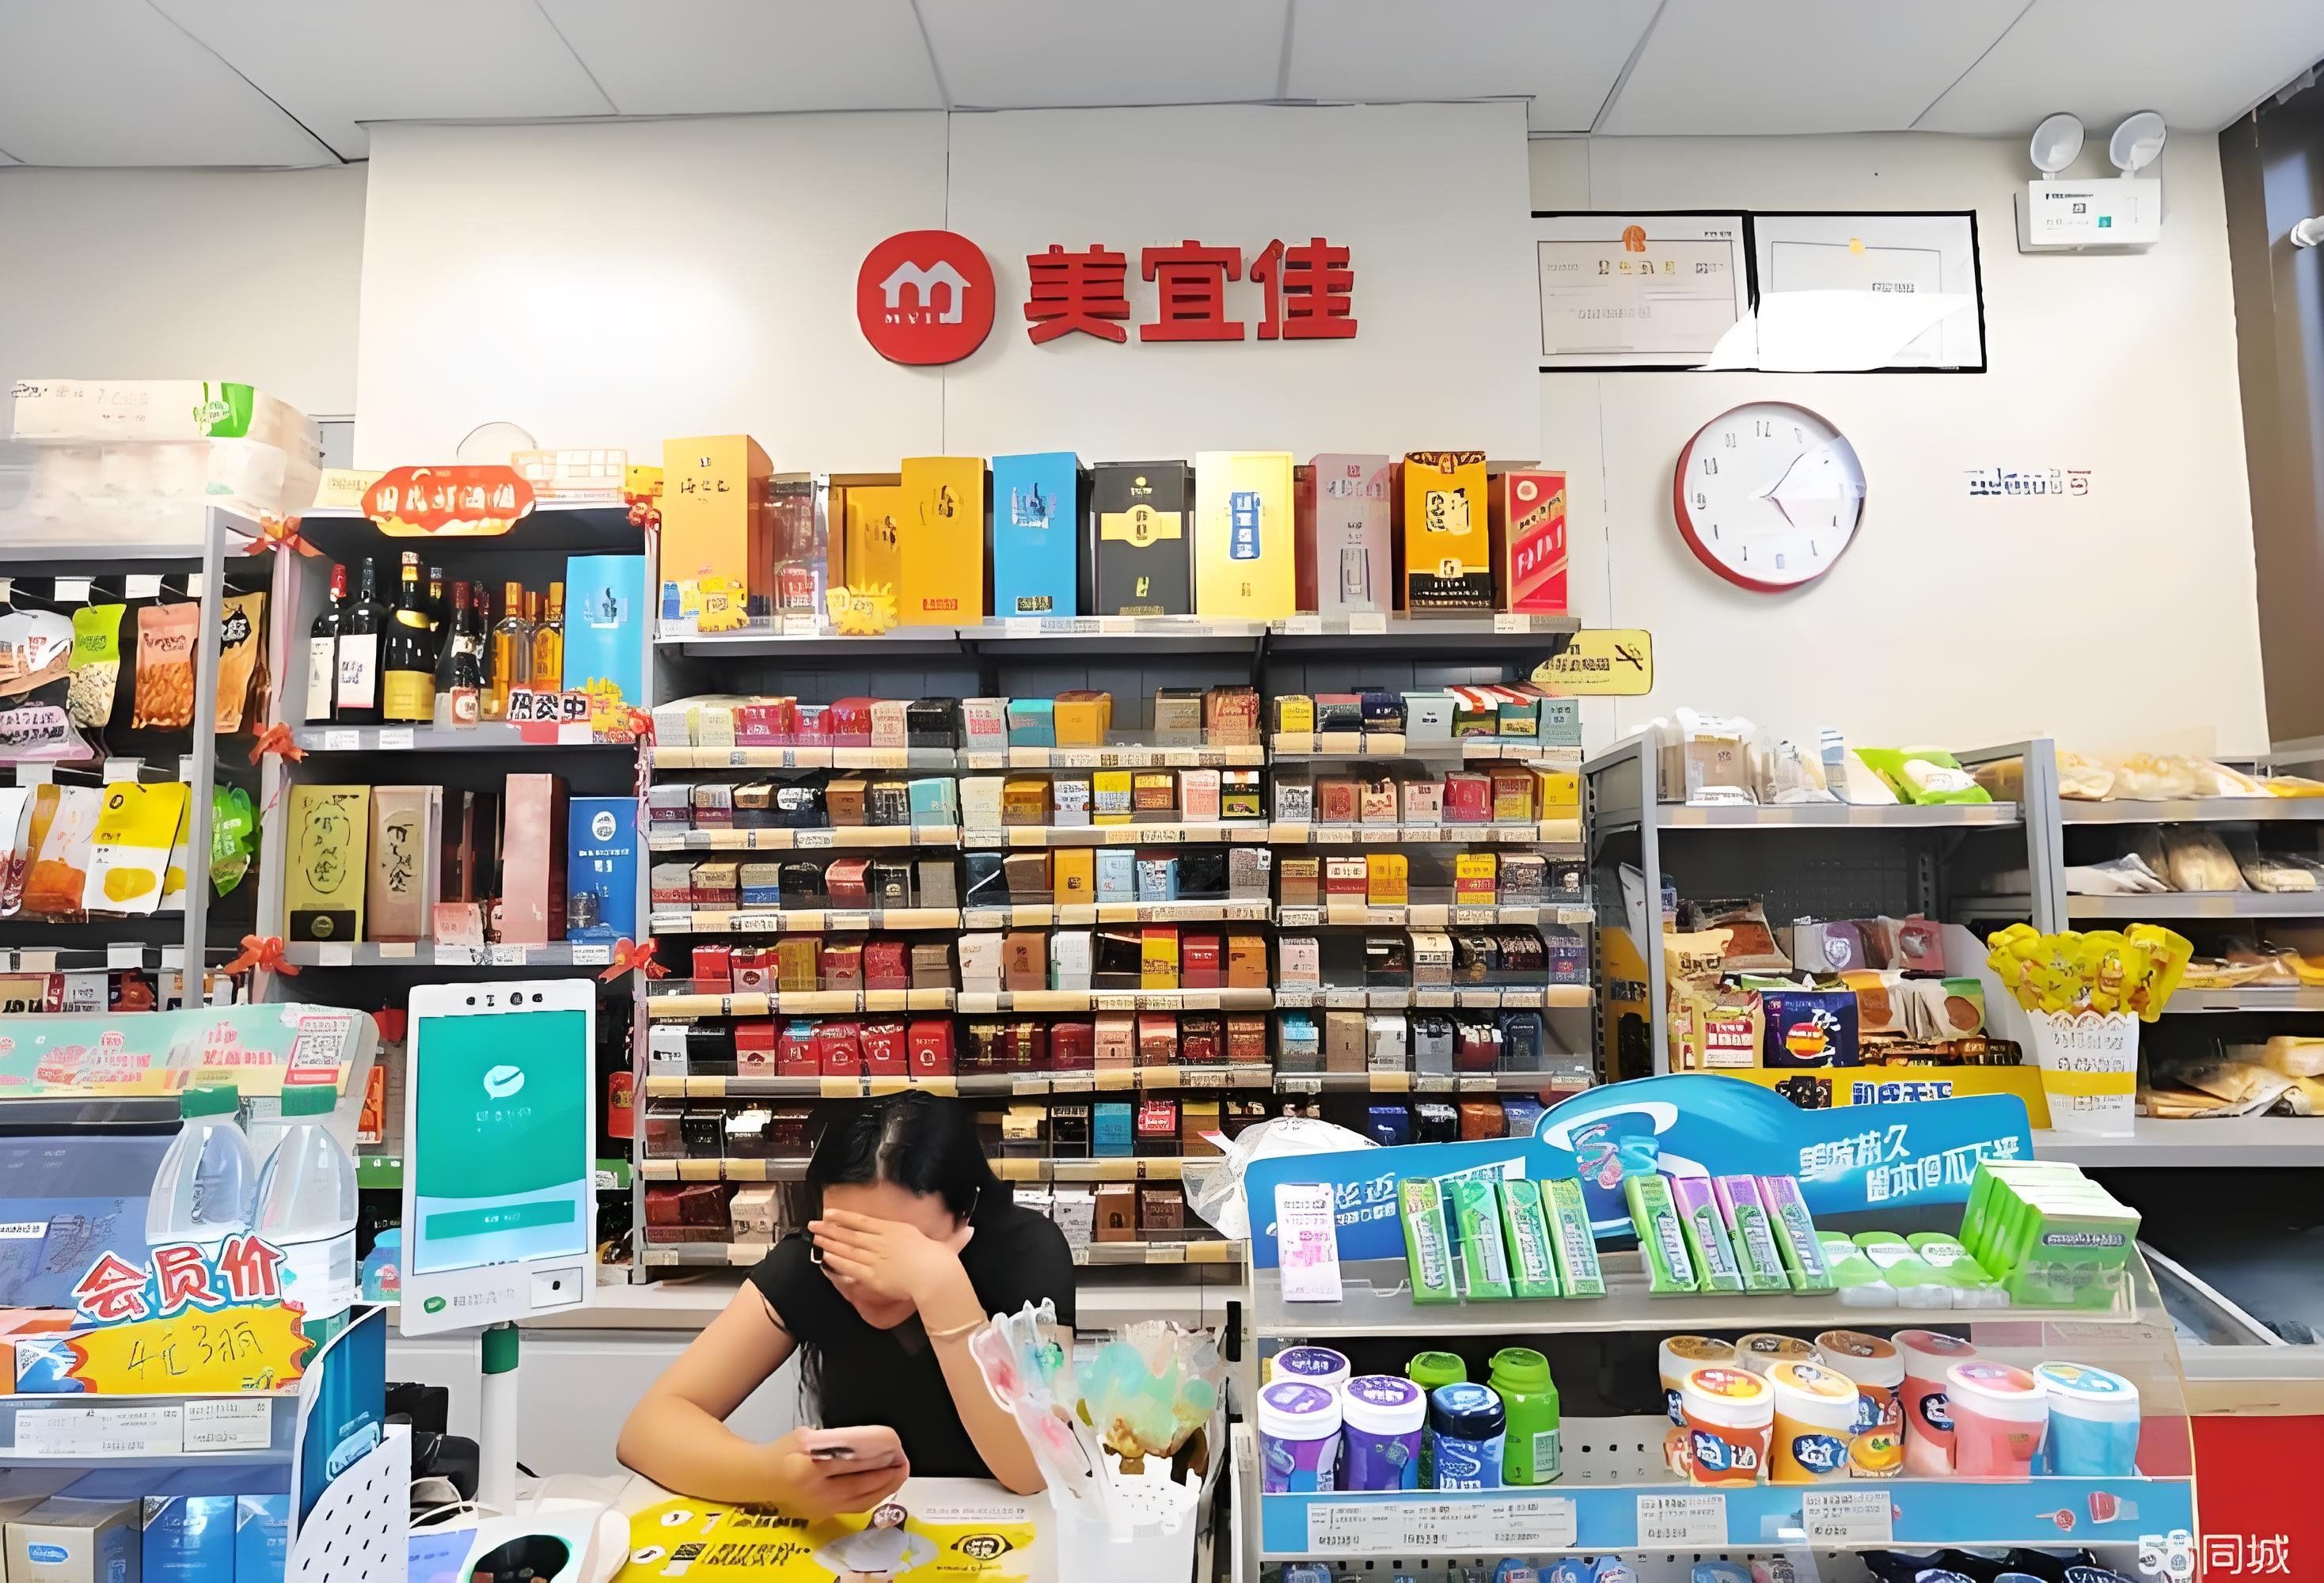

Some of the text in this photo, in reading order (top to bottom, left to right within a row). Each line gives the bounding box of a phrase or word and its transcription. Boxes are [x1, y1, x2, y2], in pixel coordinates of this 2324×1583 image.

[1024, 238, 1357, 345] 美宜佳
[76, 1235, 282, 1318] 会员价
